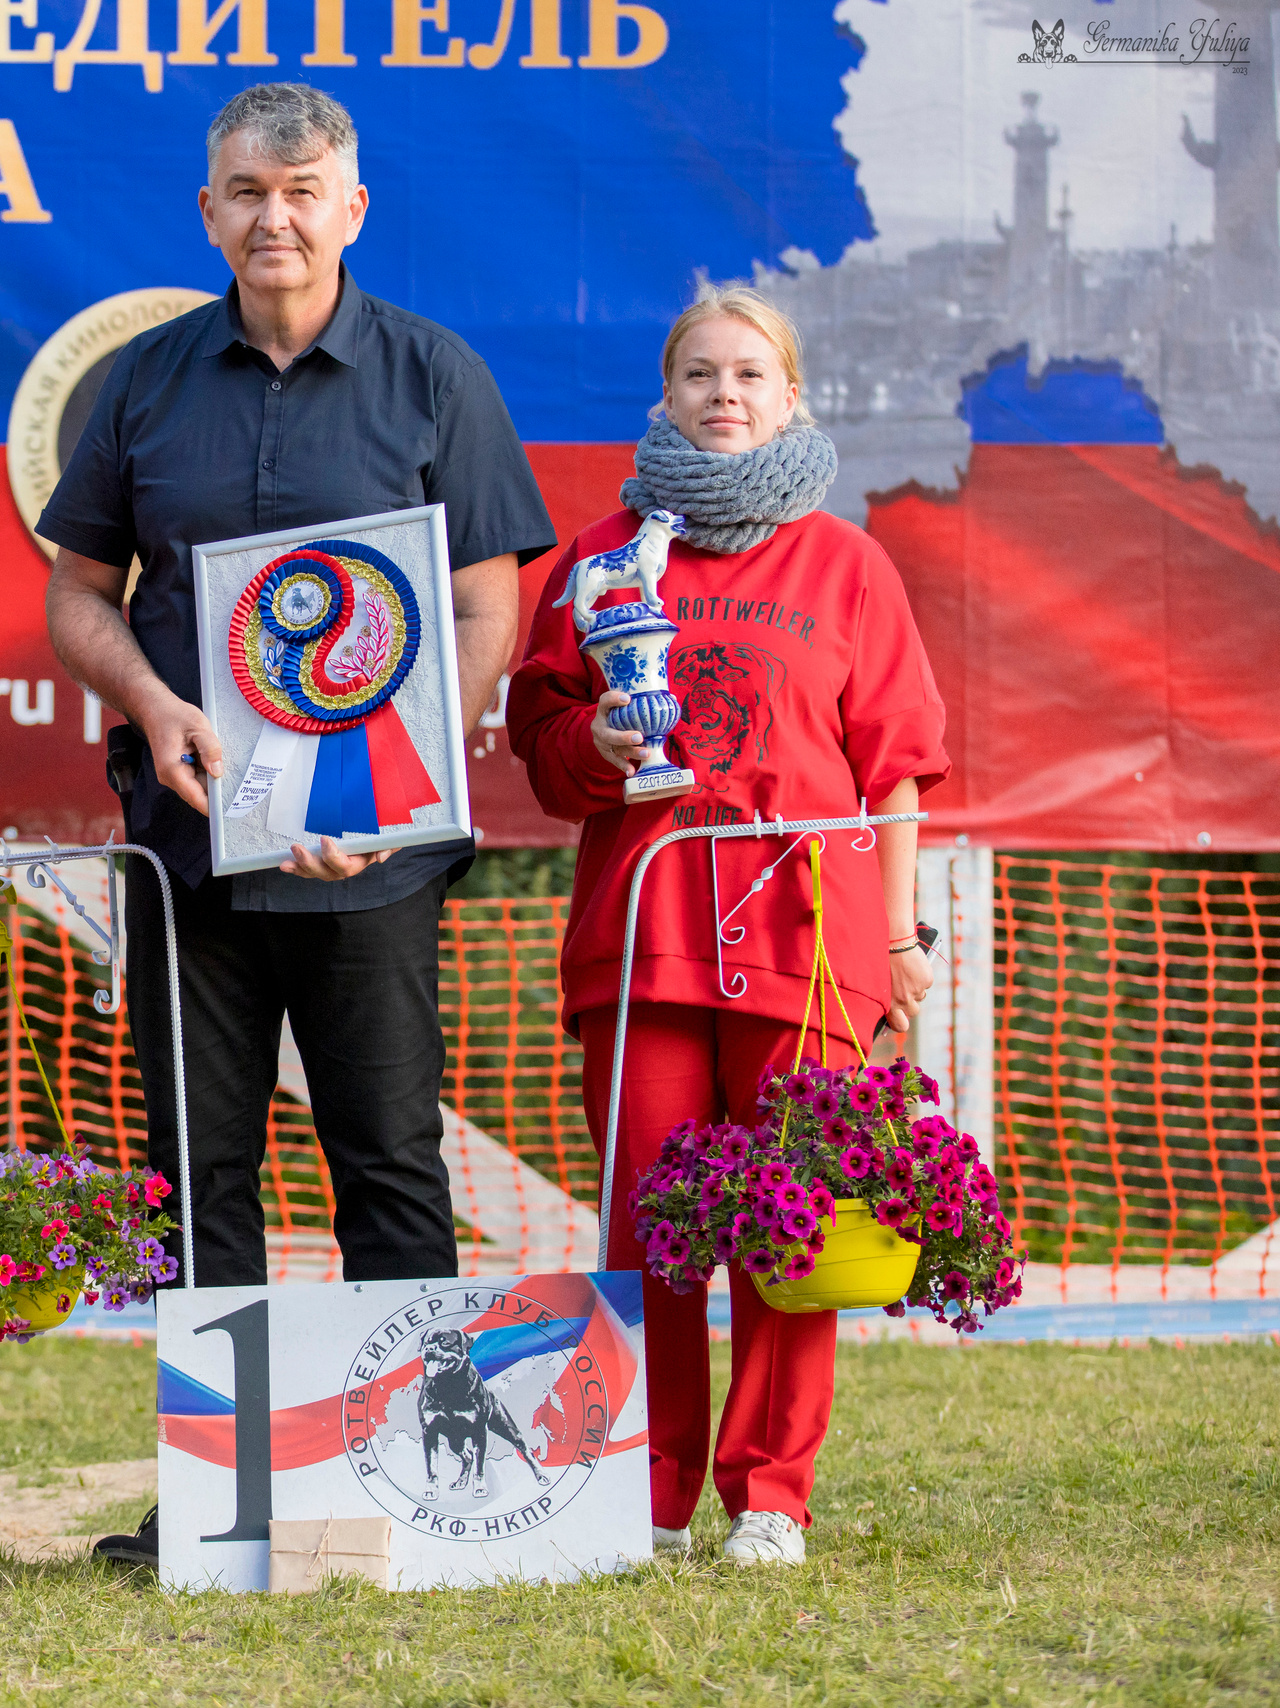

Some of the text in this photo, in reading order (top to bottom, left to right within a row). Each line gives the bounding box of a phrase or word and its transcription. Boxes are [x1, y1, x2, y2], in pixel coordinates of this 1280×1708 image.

[676, 597, 816, 649] ROTTWEILER,
[672, 805, 696, 827] NO
[348, 1291, 606, 1479] РОТВЕЙЛЕР КЛУБ РОССИИ
[192, 1299, 273, 1543] 1
[410, 1495, 553, 1537] РКФ-НКПР
